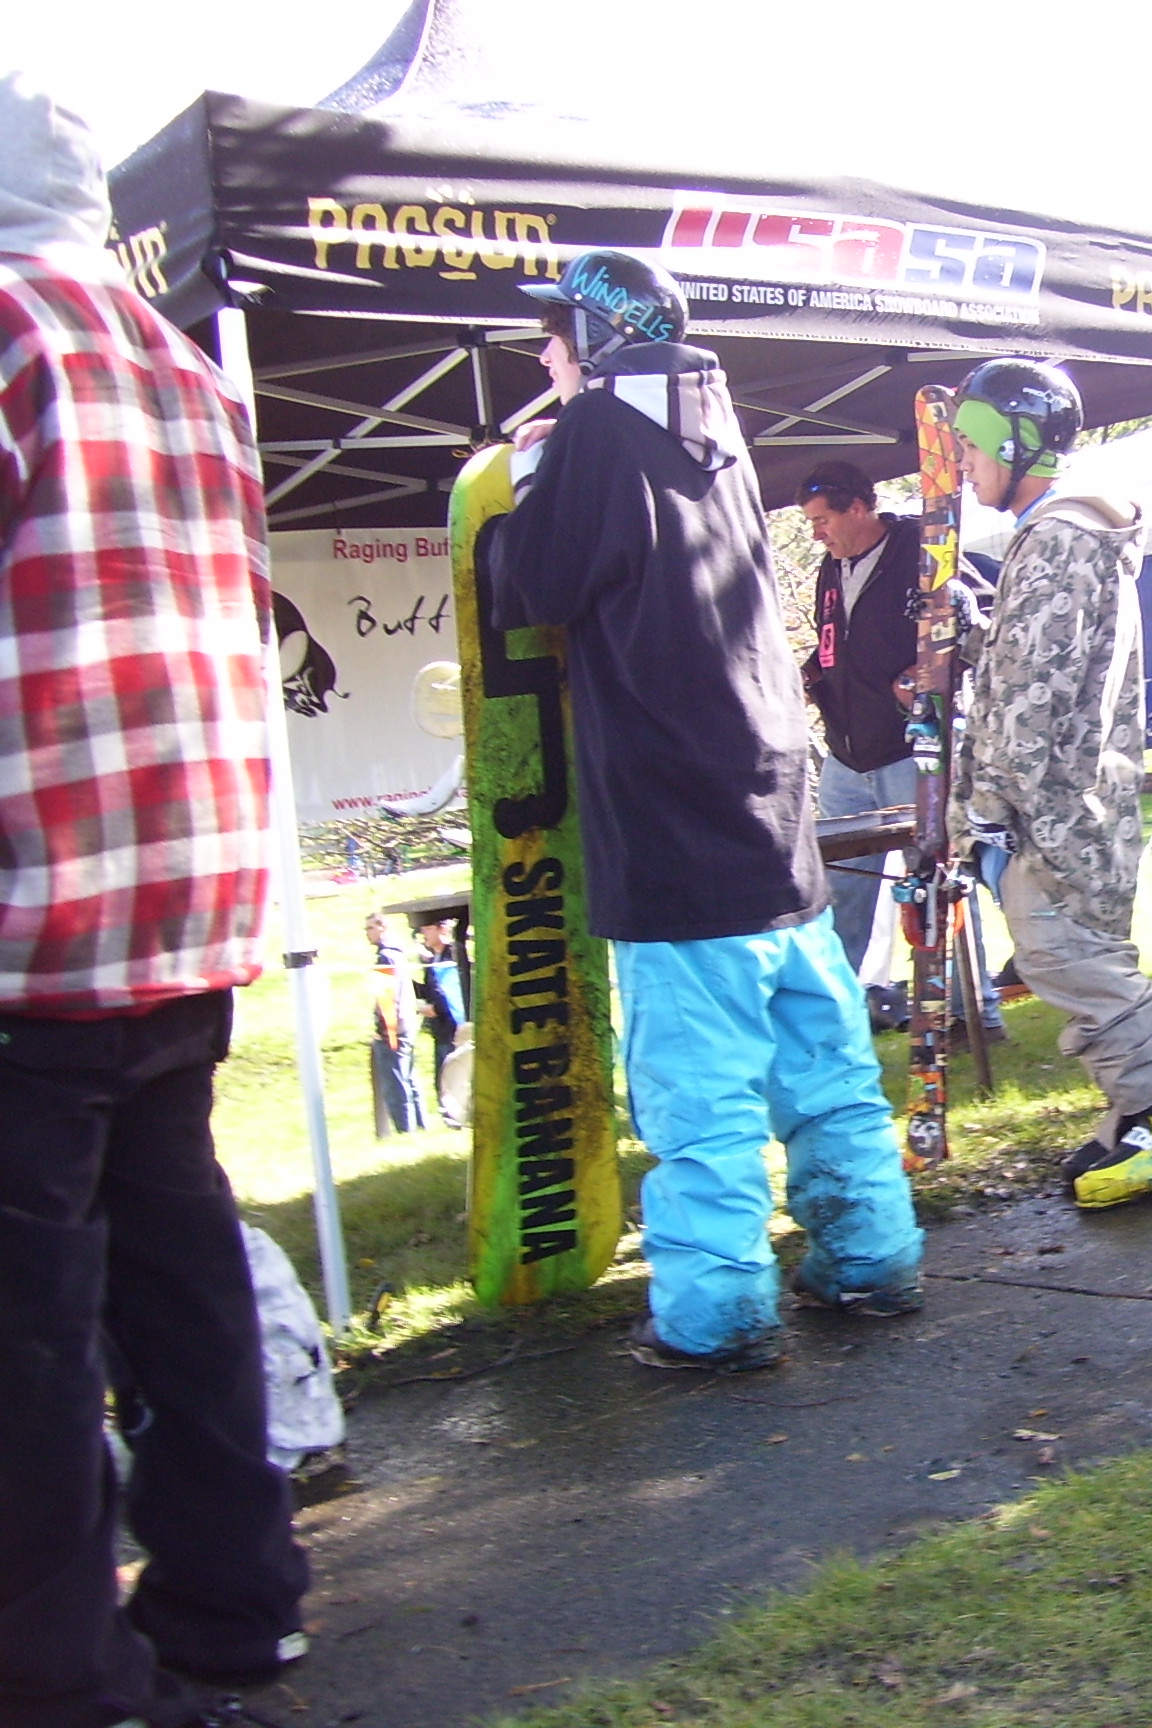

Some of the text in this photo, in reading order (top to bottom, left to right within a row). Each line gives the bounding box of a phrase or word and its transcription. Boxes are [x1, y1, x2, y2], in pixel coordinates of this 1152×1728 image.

[307, 195, 563, 282] PACSUN
[731, 284, 785, 305] STATES
[787, 288, 809, 307] OF
[809, 290, 873, 312] AMERICA
[332, 538, 408, 564] Raging
[504, 856, 570, 1036] SKATE
[513, 1042, 579, 1267] BANANA
